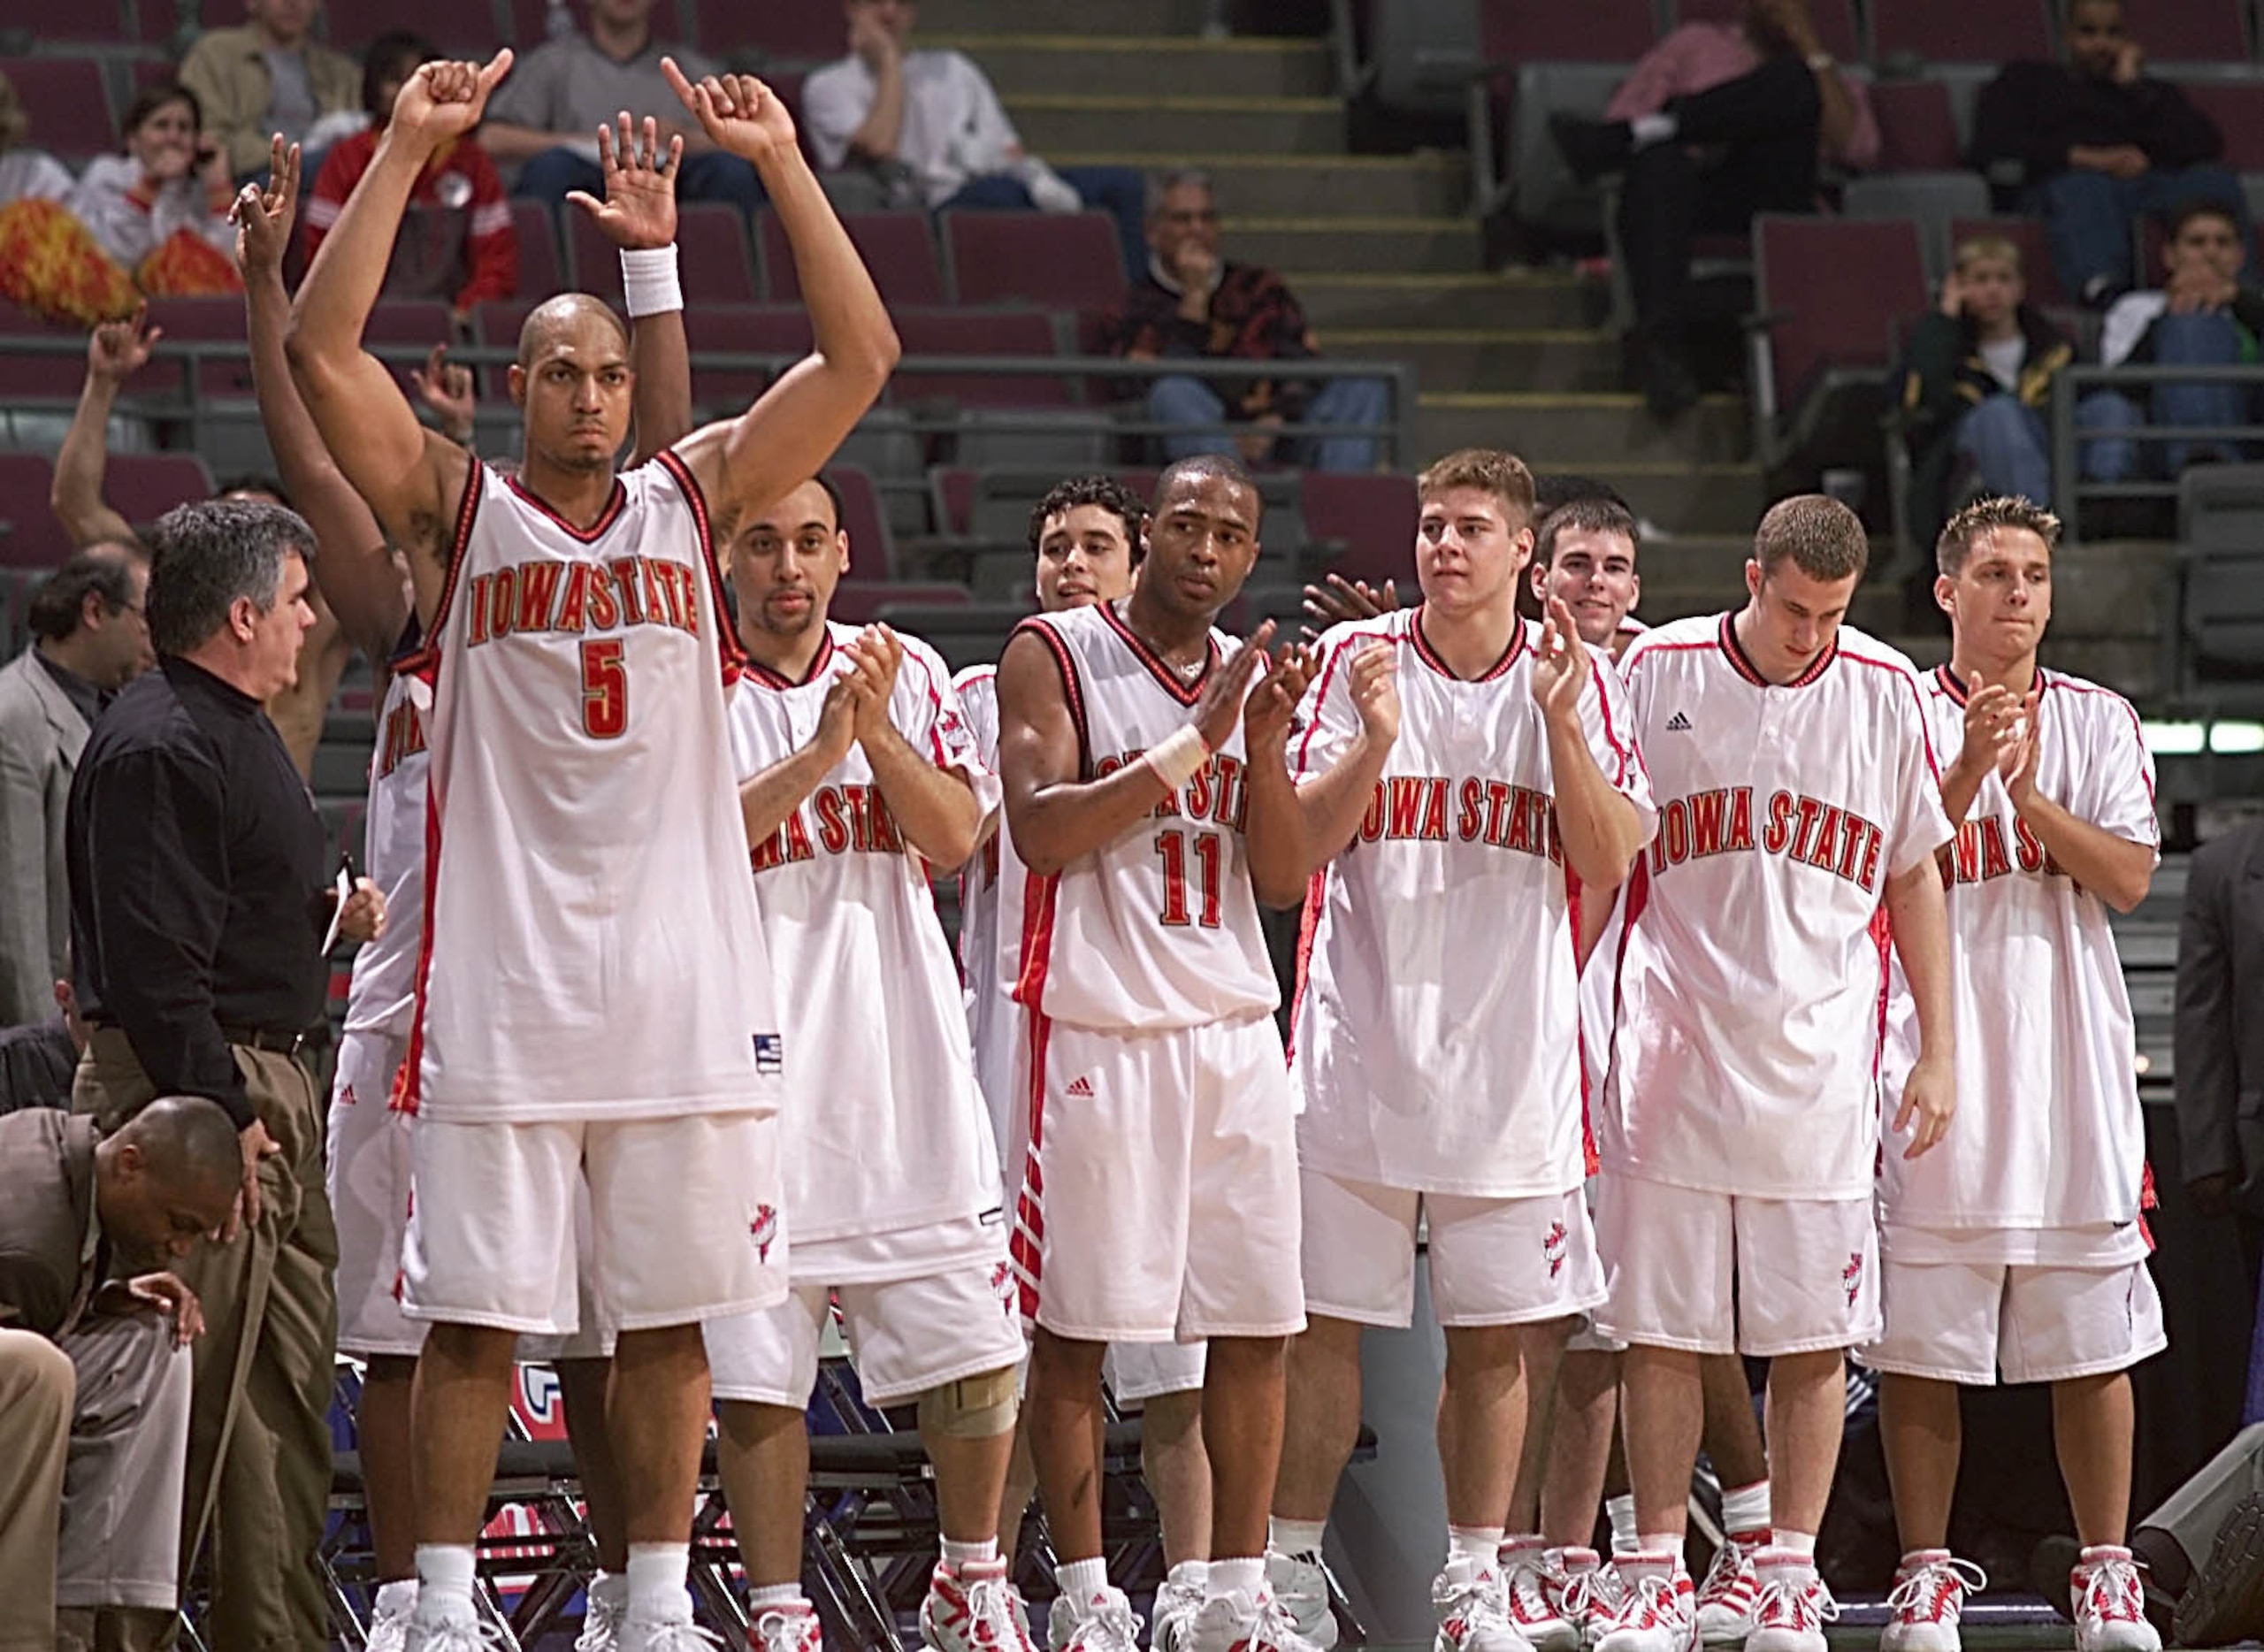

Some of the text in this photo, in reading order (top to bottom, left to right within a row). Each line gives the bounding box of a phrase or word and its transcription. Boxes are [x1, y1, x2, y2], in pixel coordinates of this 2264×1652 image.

[467, 554, 700, 648] IOWA STATE
[579, 638, 627, 740] 5
[815, 784, 904, 855] STA
[1346, 776, 1449, 853] OWA
[1651, 786, 1883, 894] IOWA STATE
[1155, 830, 1220, 929] 11
